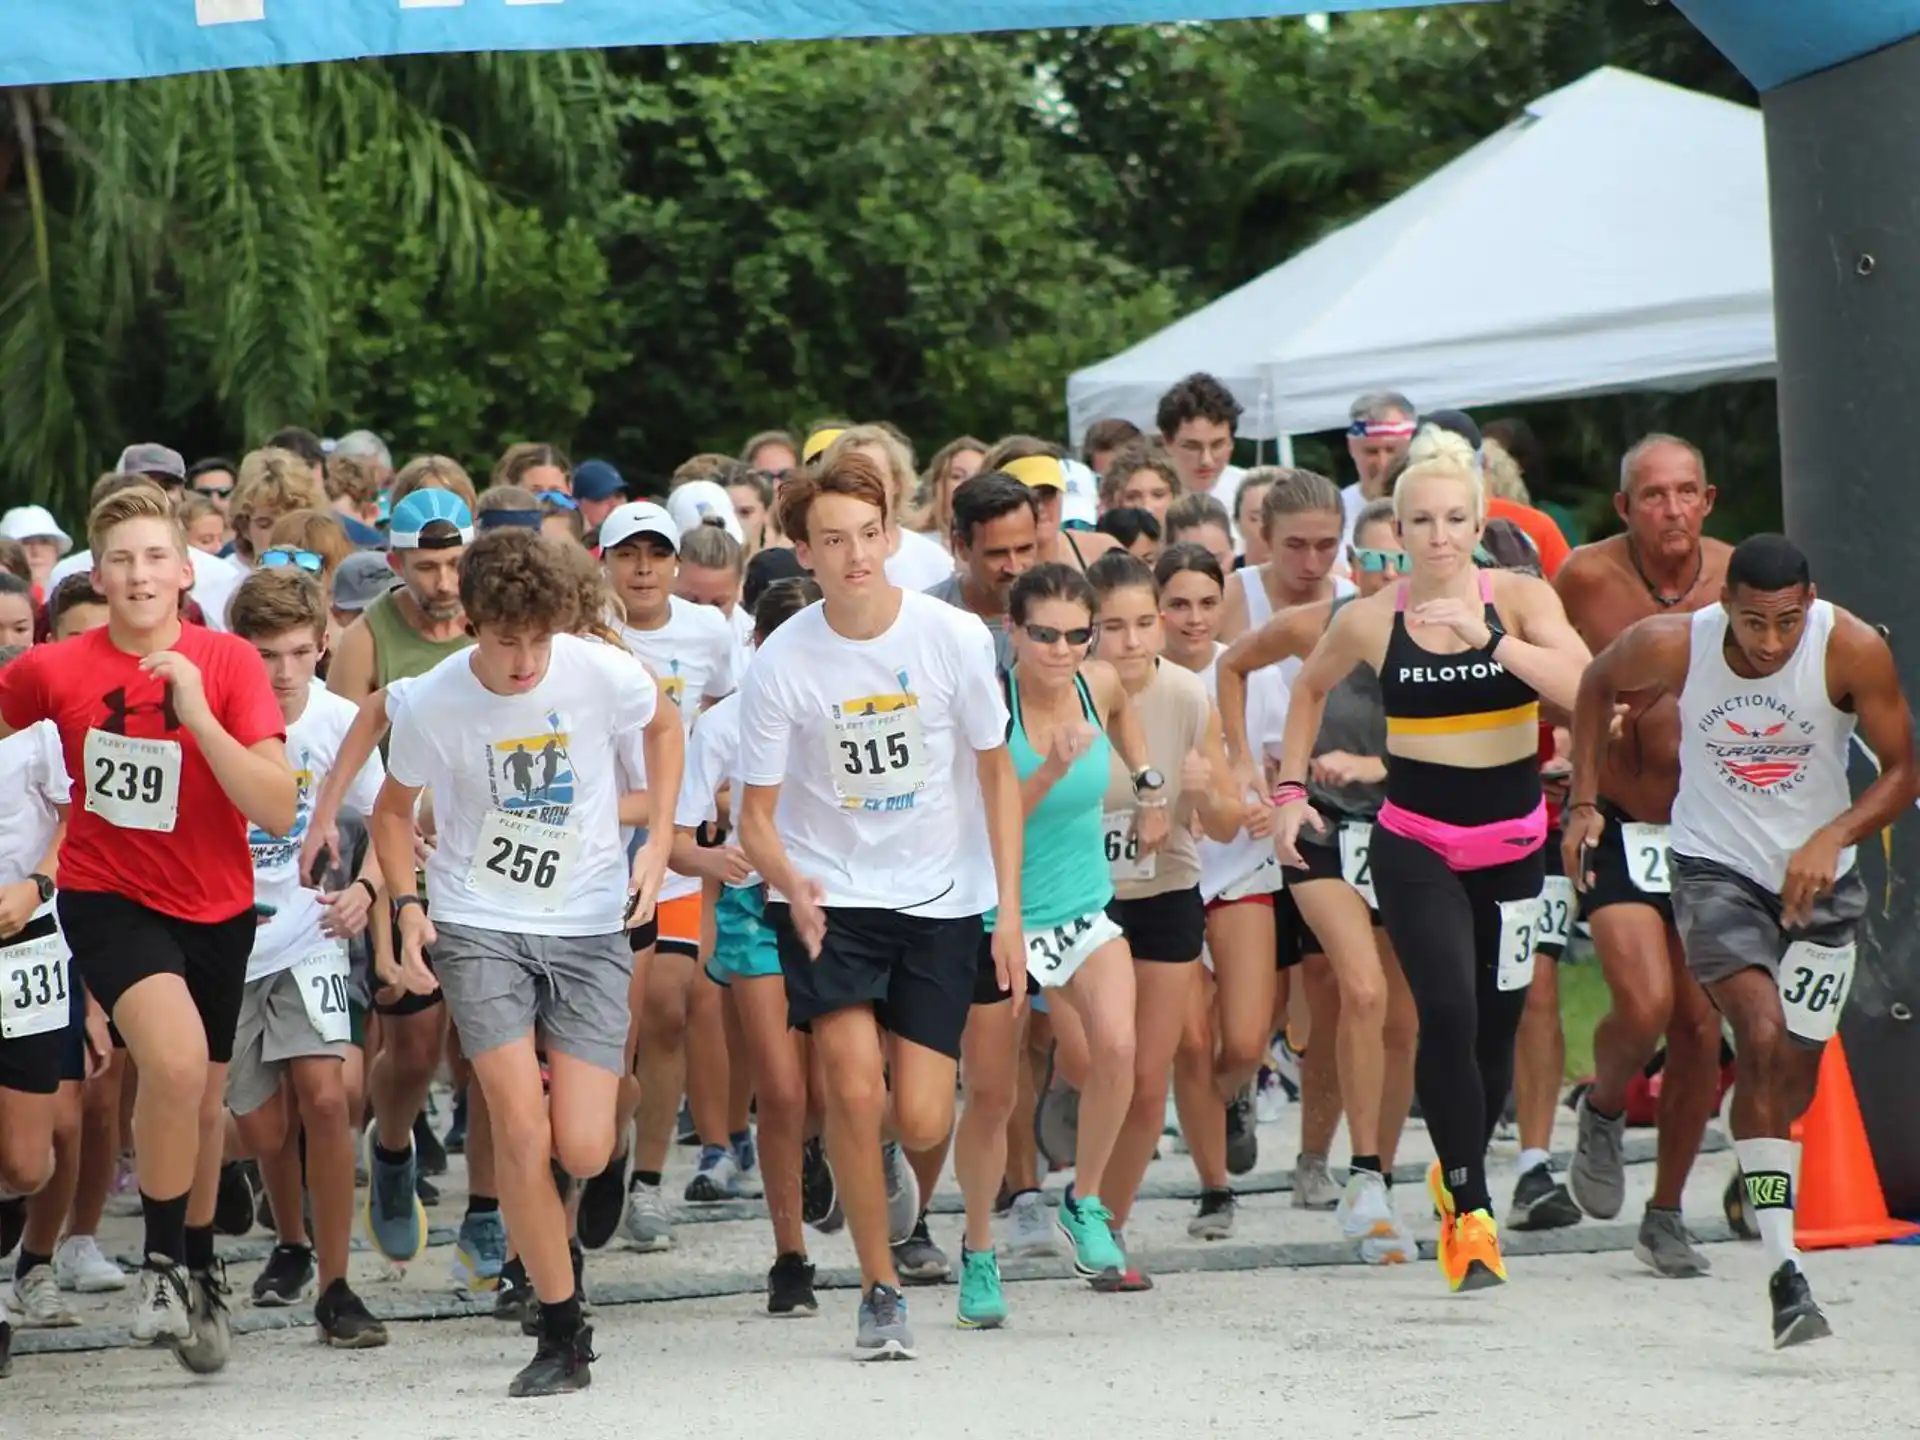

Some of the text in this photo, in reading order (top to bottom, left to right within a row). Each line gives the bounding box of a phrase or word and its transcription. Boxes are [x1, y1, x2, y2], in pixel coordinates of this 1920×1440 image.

[1399, 661, 1504, 683] PELOTON
[1698, 694, 1797, 733] FUNCTIONAL
[840, 732, 910, 775] 315
[95, 757, 164, 804] 239
[486, 836, 560, 889] 256
[1030, 915, 1092, 971] 344
[11, 960, 66, 1009] 331
[311, 973, 349, 1014] 20
[1783, 967, 1846, 1013] 364
